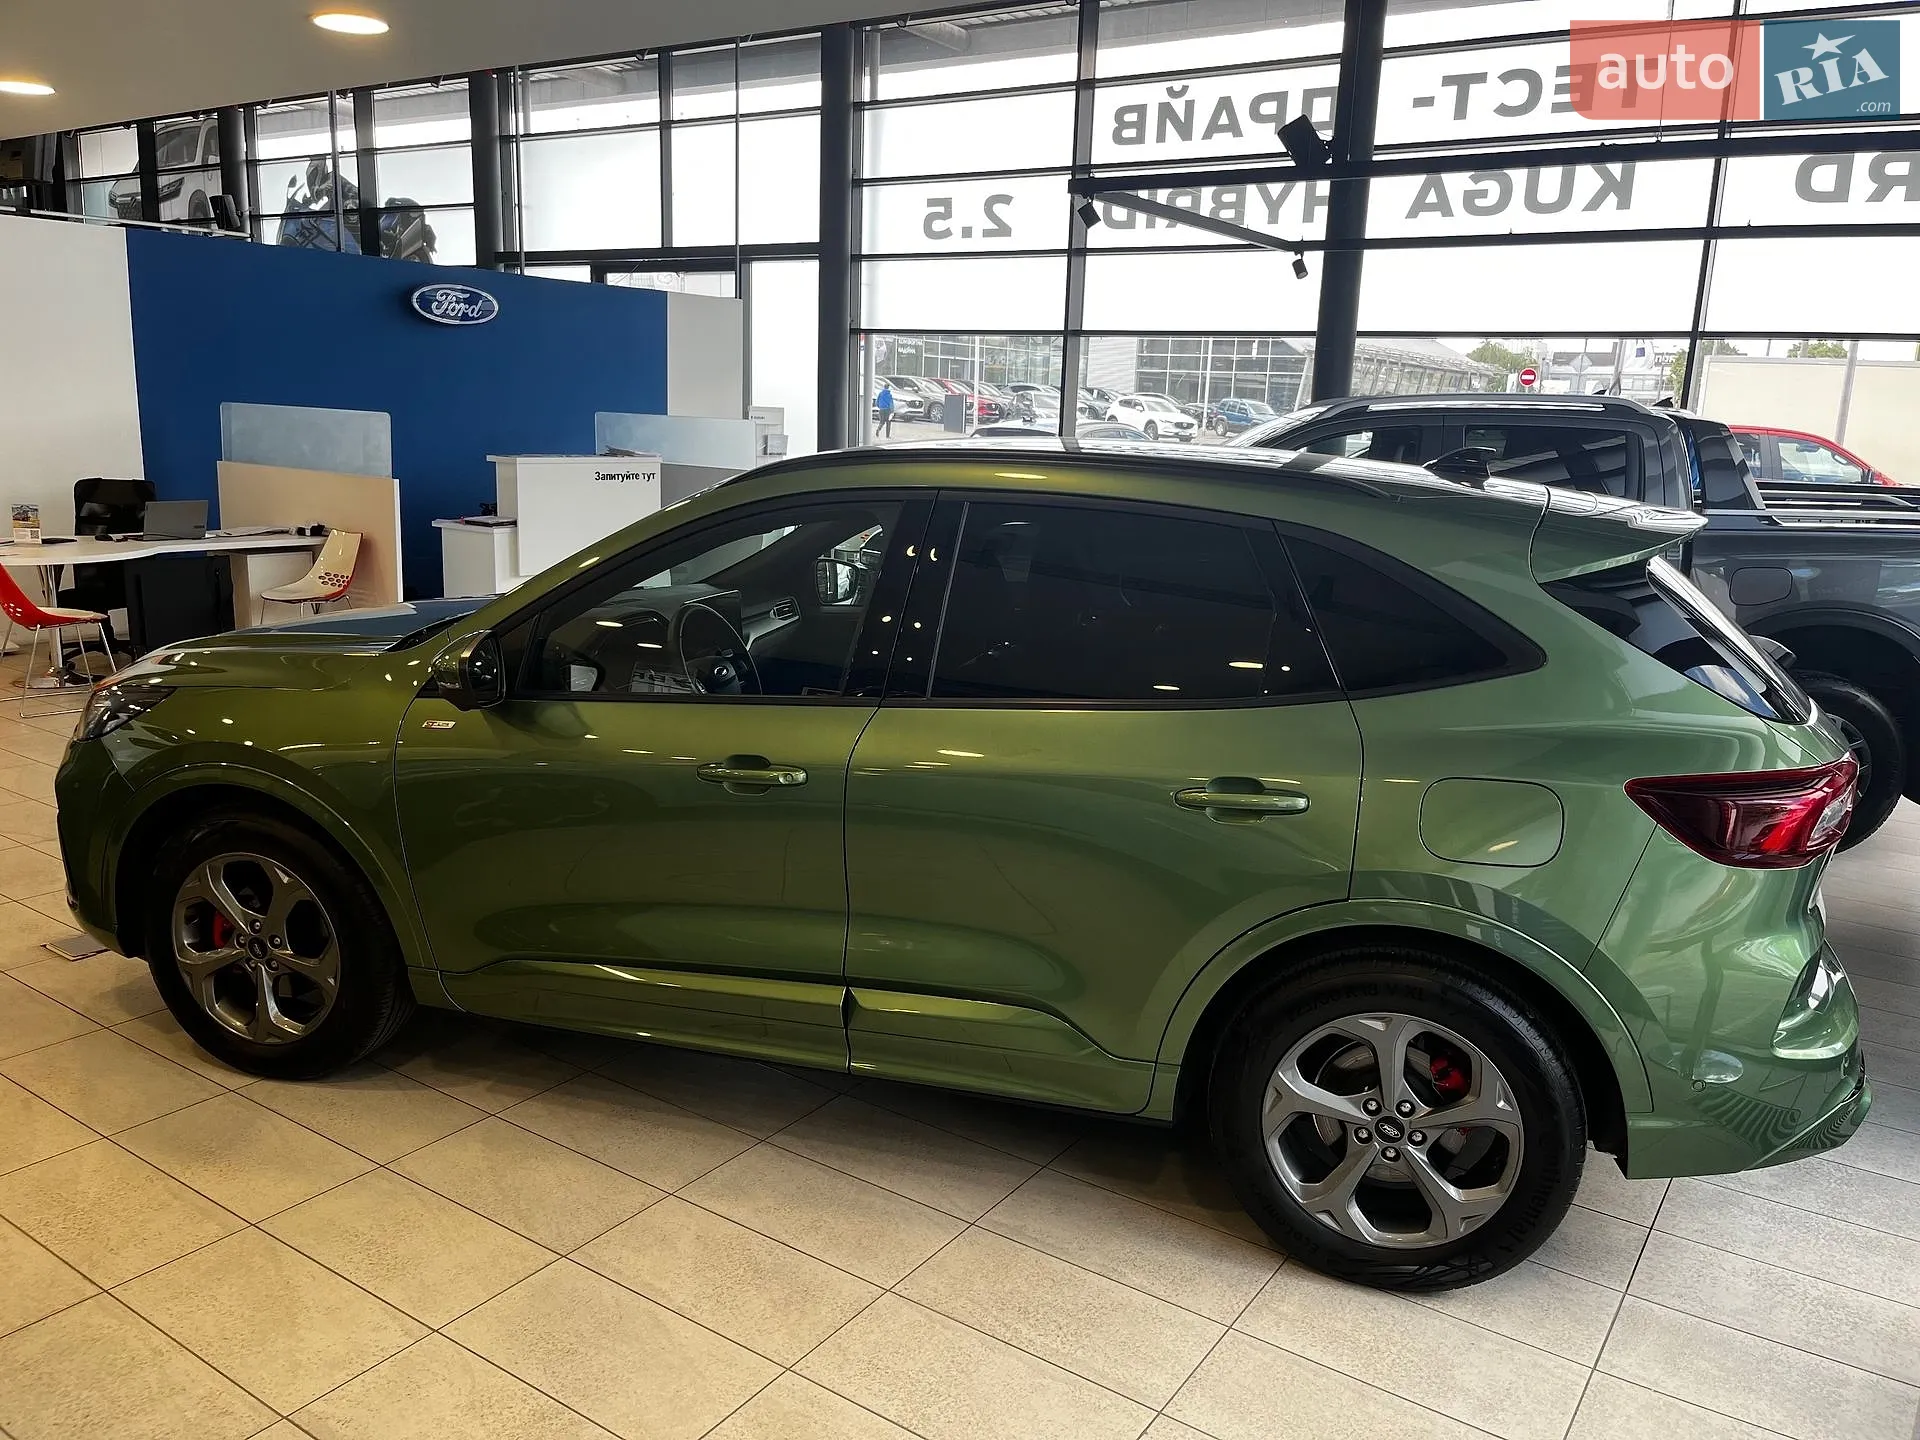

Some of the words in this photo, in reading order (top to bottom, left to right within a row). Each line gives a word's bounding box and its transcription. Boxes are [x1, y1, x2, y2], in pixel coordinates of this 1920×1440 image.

[431, 289, 483, 318] Ford
[594, 471, 640, 483] Запитуйте
[641, 472, 656, 482] тут
